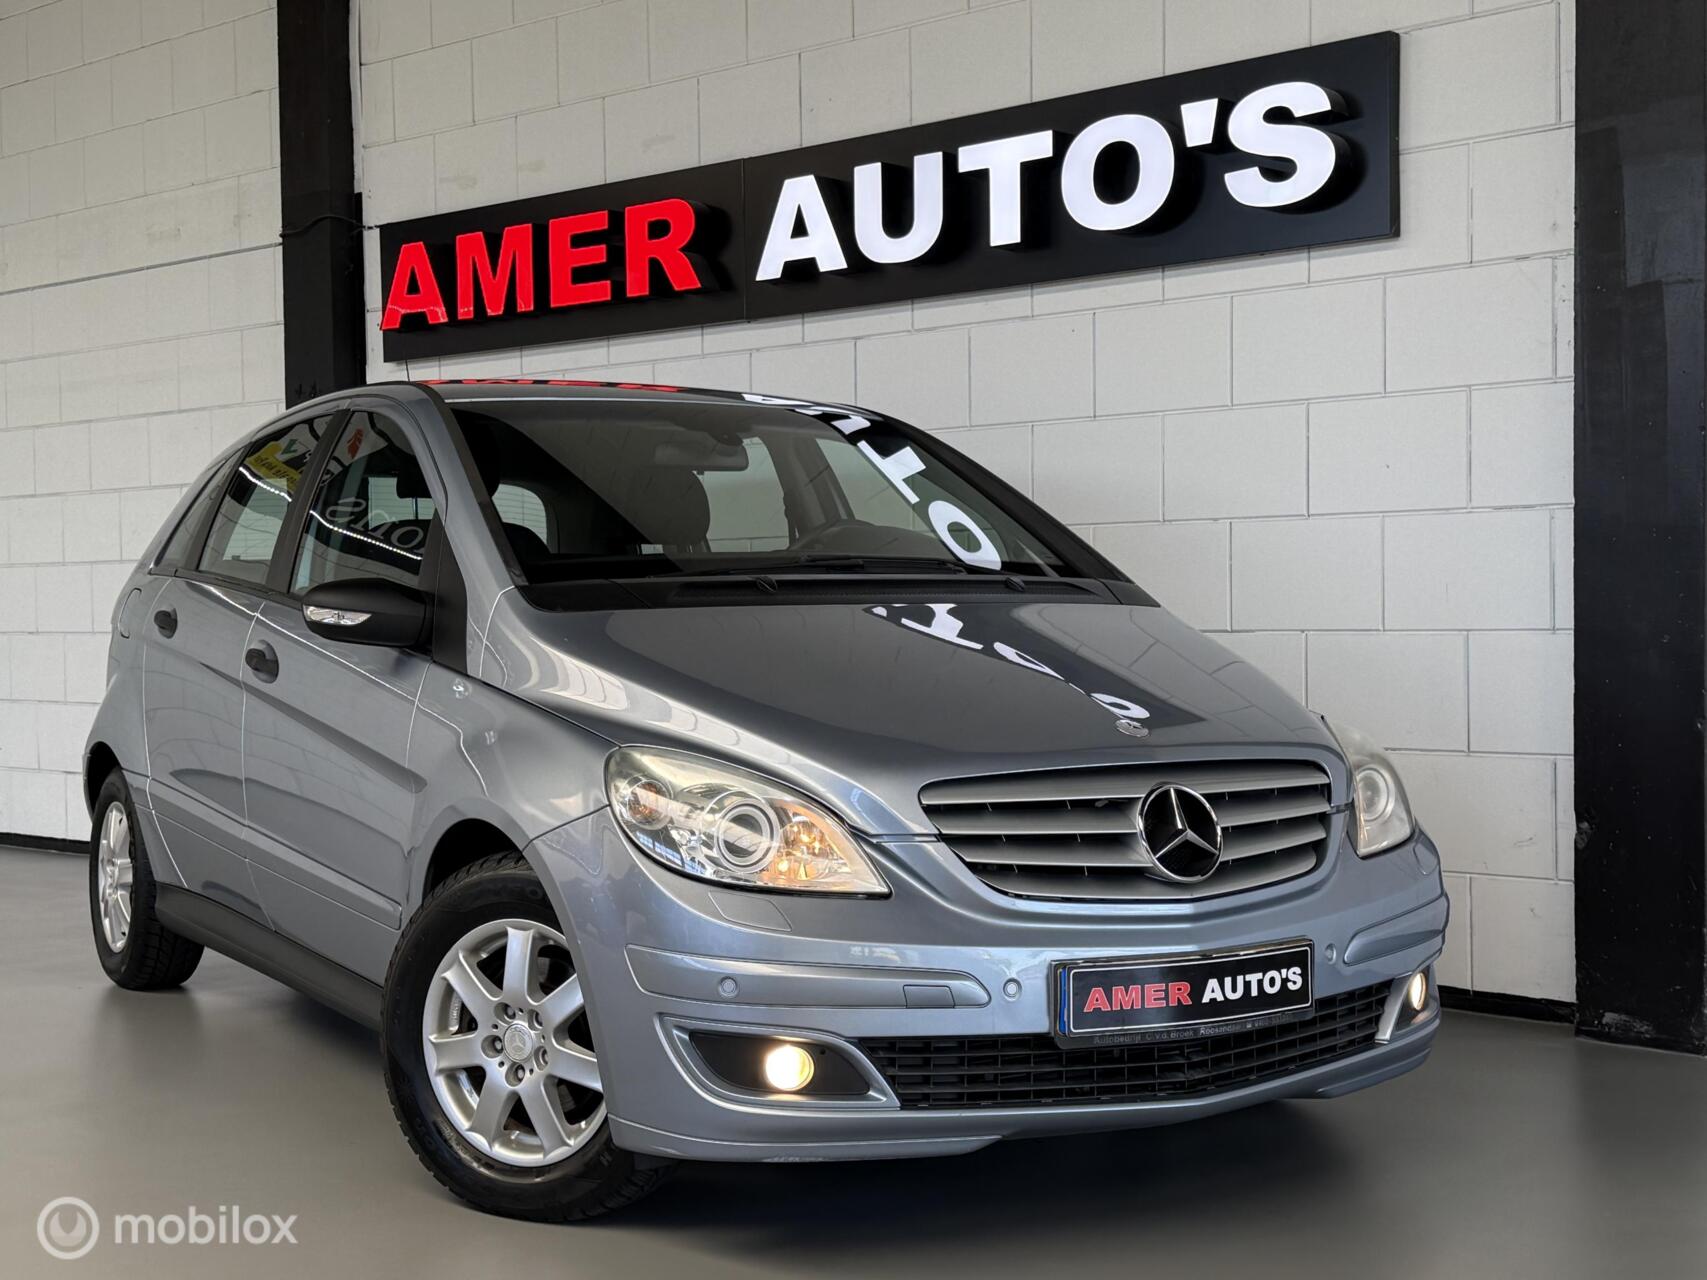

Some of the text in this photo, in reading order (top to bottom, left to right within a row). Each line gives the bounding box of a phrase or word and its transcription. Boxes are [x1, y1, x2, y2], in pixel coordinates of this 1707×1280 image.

[380, 81, 1337, 331] AMER AUTO'S
[1083, 966, 1304, 1013] AMER AUTO'S
